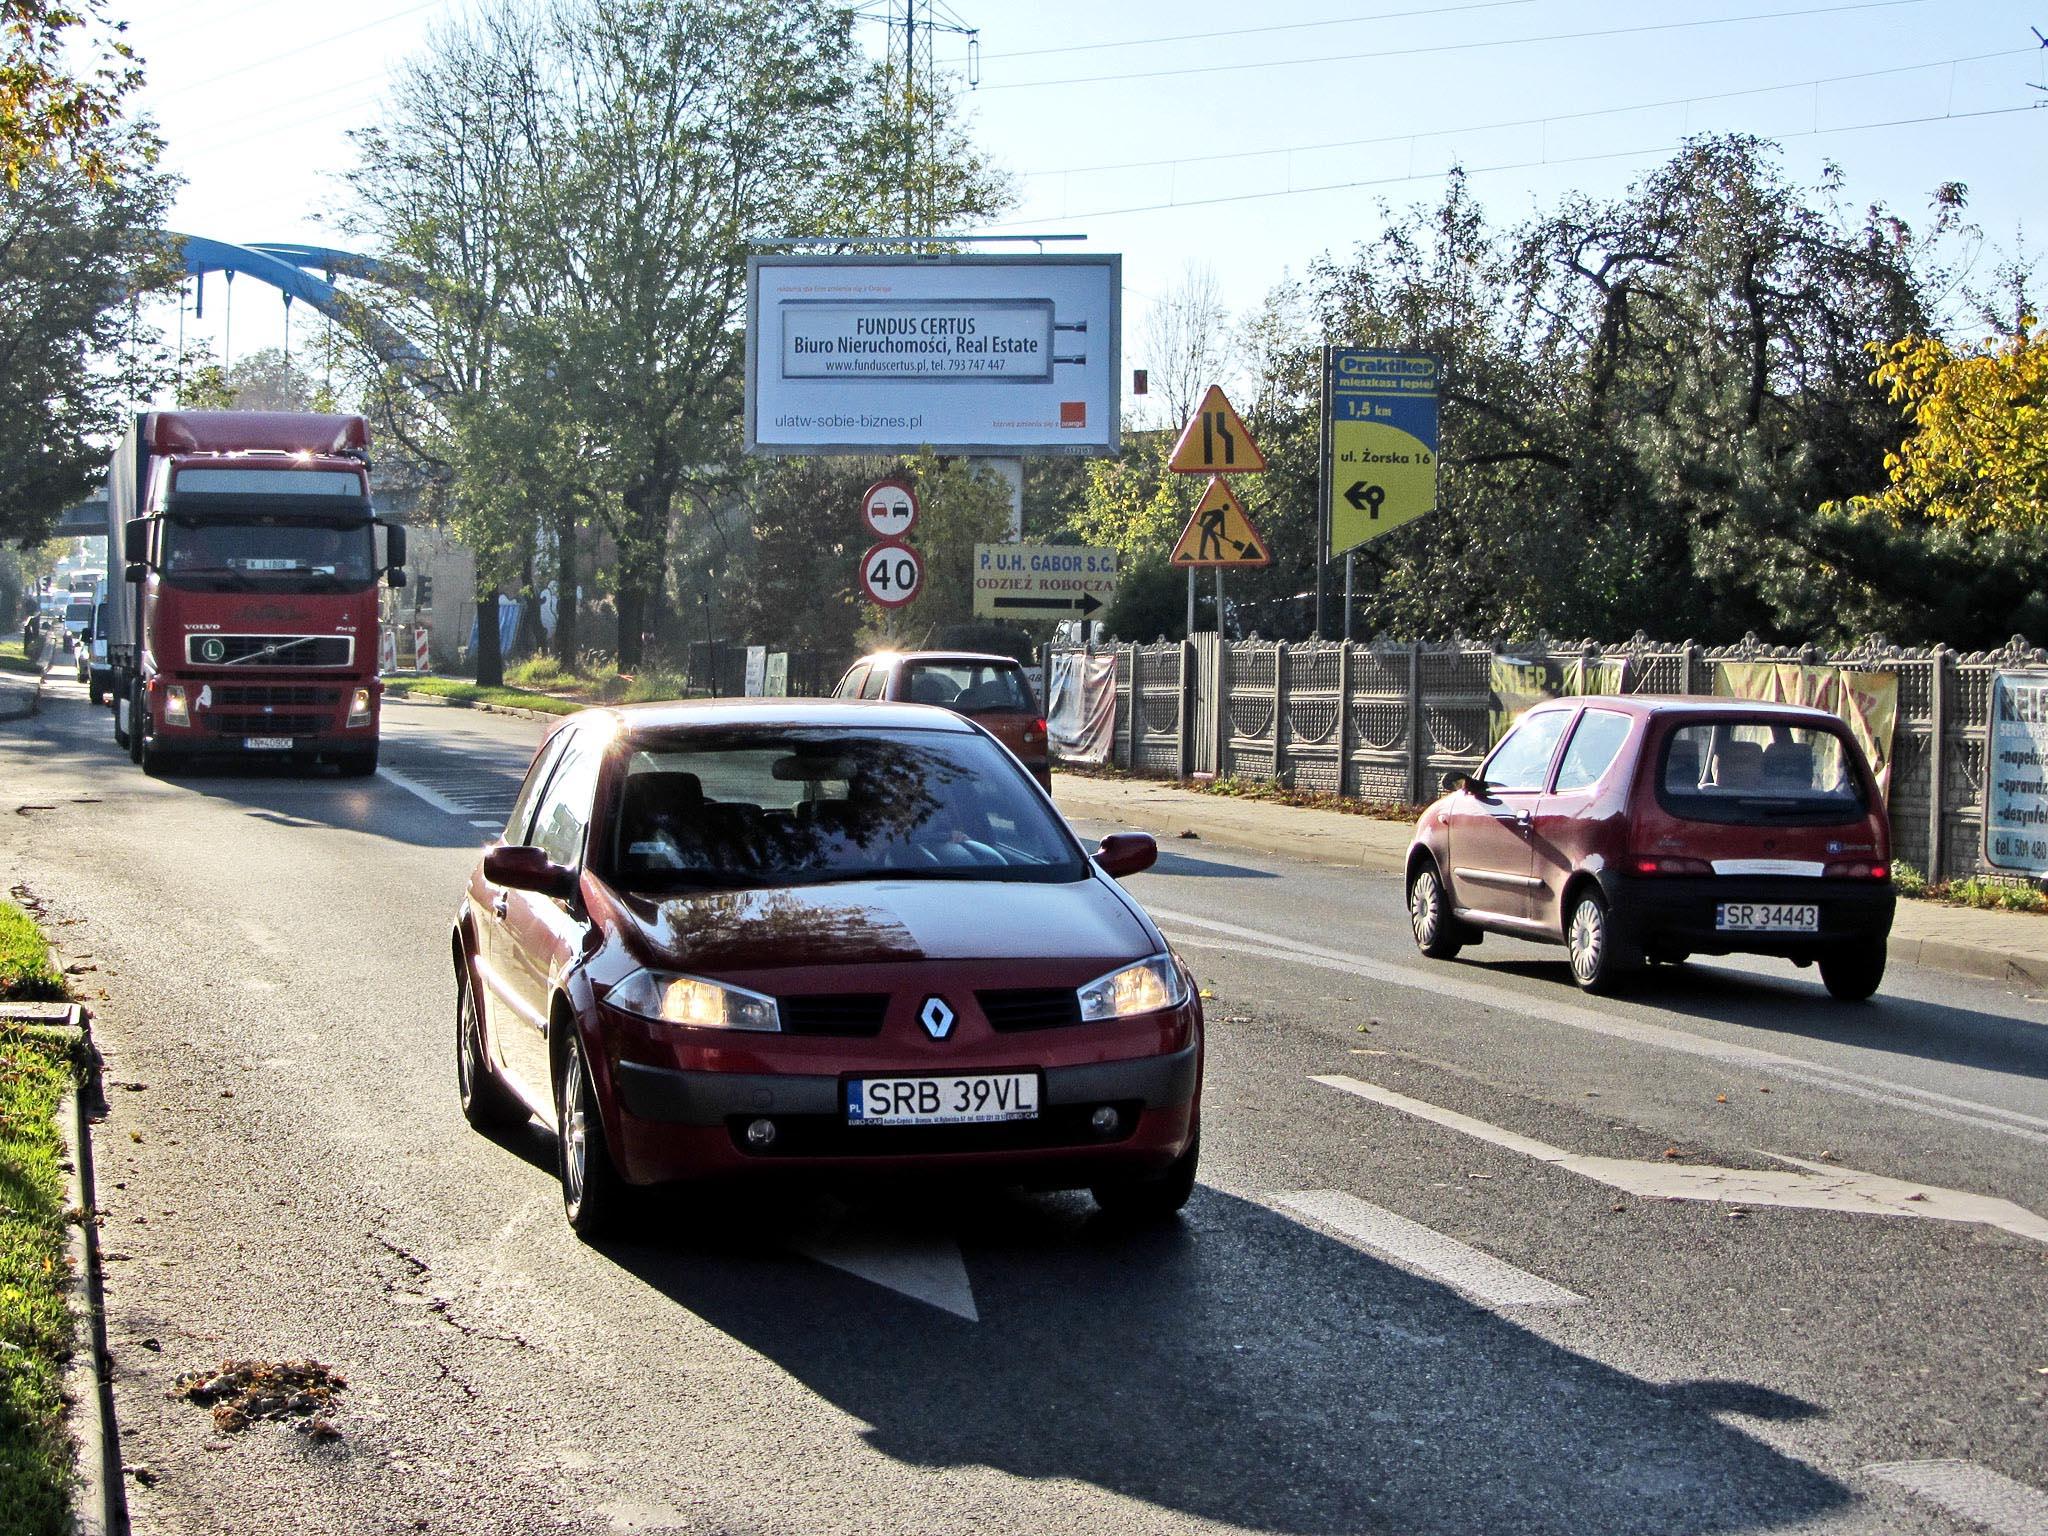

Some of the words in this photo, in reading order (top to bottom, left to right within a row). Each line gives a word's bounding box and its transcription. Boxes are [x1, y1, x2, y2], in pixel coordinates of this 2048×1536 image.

[857, 318, 917, 335] FUNDUS
[920, 317, 976, 335] CERTUS
[794, 336, 834, 354] Biuro
[838, 335, 952, 356] Nieruchomości,
[956, 335, 987, 353] Real
[992, 335, 1038, 353] Estate
[826, 359, 929, 373] www.funduscertus.pl,
[931, 359, 946, 371] tel.
[948, 359, 966, 371] 793
[968, 359, 986, 371] 747
[988, 359, 1006, 371] 447
[1343, 358, 1434, 375] Praktiker
[1348, 400, 1371, 418] 1,5
[1375, 404, 1393, 417] km
[775, 414, 923, 430] ulatw-sobie-biznes.pl
[1341, 450, 1357, 463] ul.
[1361, 448, 1410, 464] Żorska
[1415, 453, 1431, 465] 16
[1030, 555, 1083, 572] GABOR
[1087, 556, 1114, 572] S.C.
[870, 559, 915, 590] 40
[976, 574, 1033, 590] ODZIEŻ
[1039, 579, 1114, 592] ROBOCZA
[184, 623, 221, 631] VOLVO
[208, 643, 218, 657] L
[1996, 838, 2013, 857] tel.
[2032, 841, 2047, 860] 480
[1727, 905, 1753, 925] SR
[1760, 906, 1815, 926] 34443
[868, 1080, 941, 1115] SRB
[953, 1078, 1032, 1112] 39VL
[850, 1104, 861, 1113] PL
